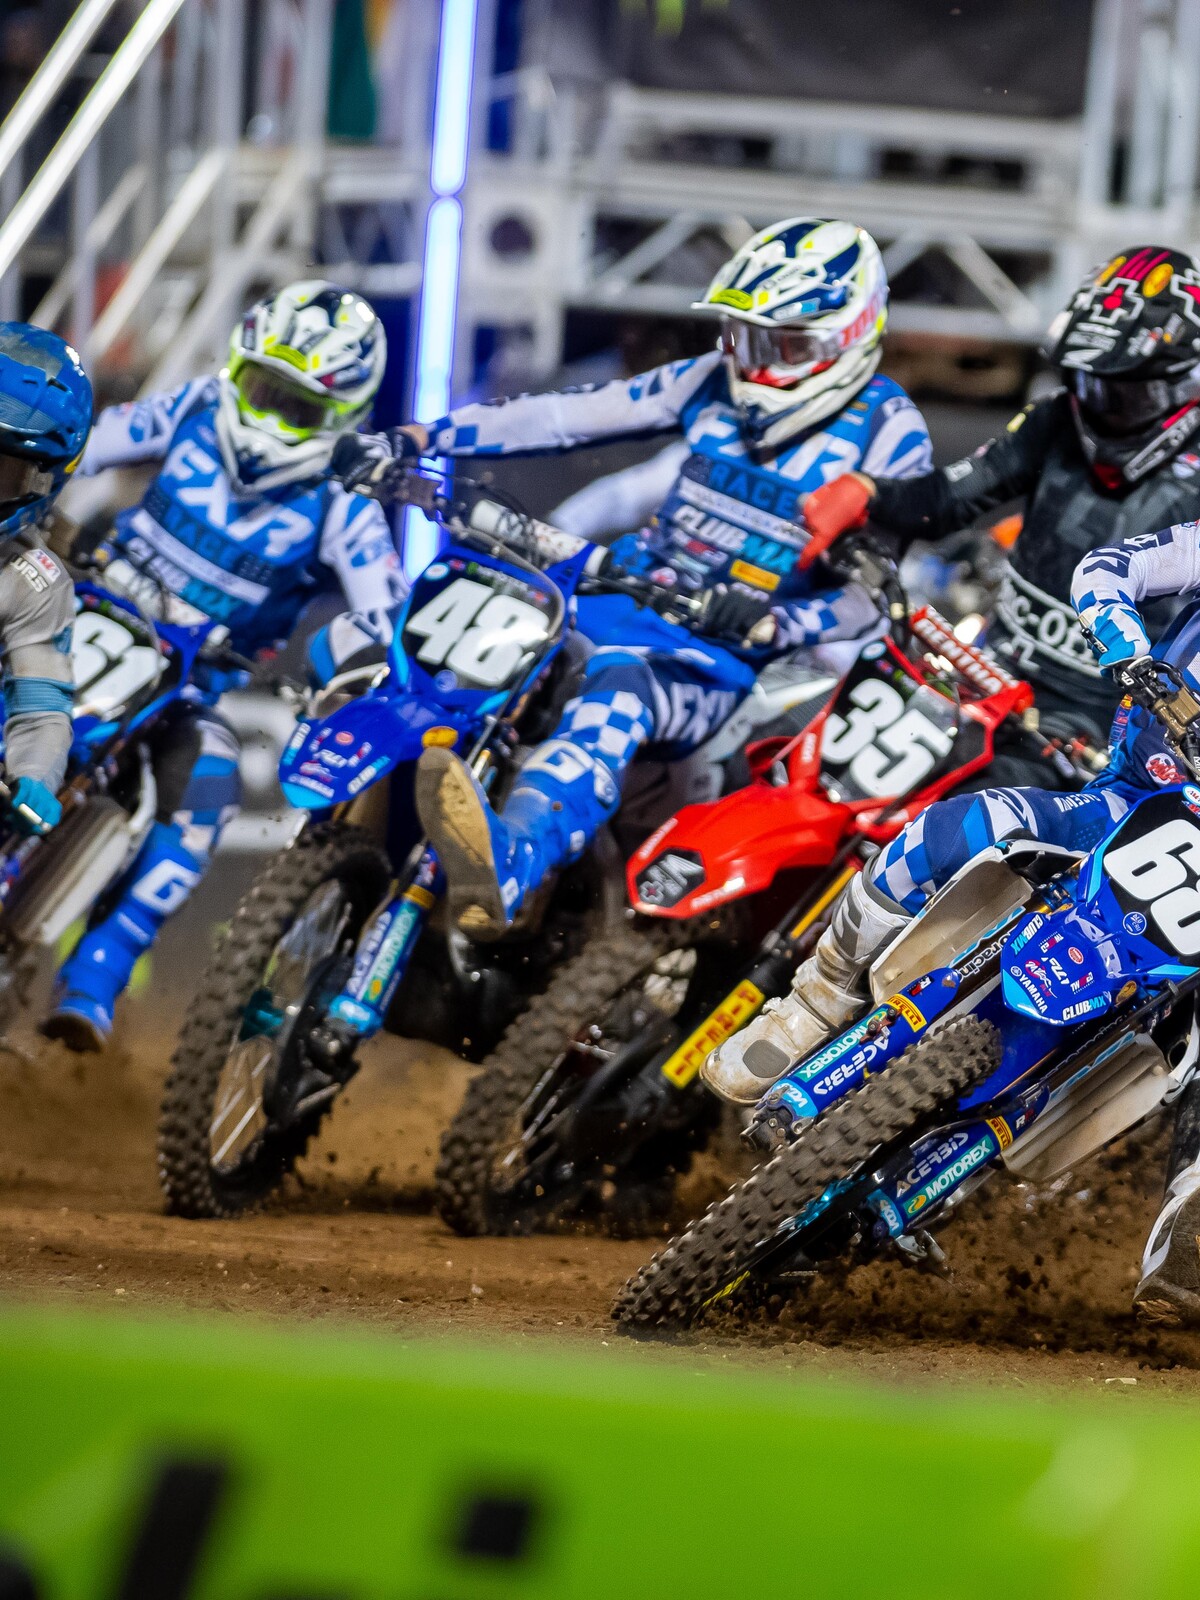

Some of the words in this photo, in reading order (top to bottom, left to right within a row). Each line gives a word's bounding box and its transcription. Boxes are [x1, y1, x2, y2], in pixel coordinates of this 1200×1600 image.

[74, 611, 166, 714] 61
[405, 577, 549, 687] 48
[821, 677, 954, 798] 35
[1010, 913, 1044, 956] CLUBMX
[1019, 973, 1049, 1014] YAMAHA
[1062, 995, 1107, 1021] CLUBMX
[924, 1139, 991, 1200] MOTOREX
